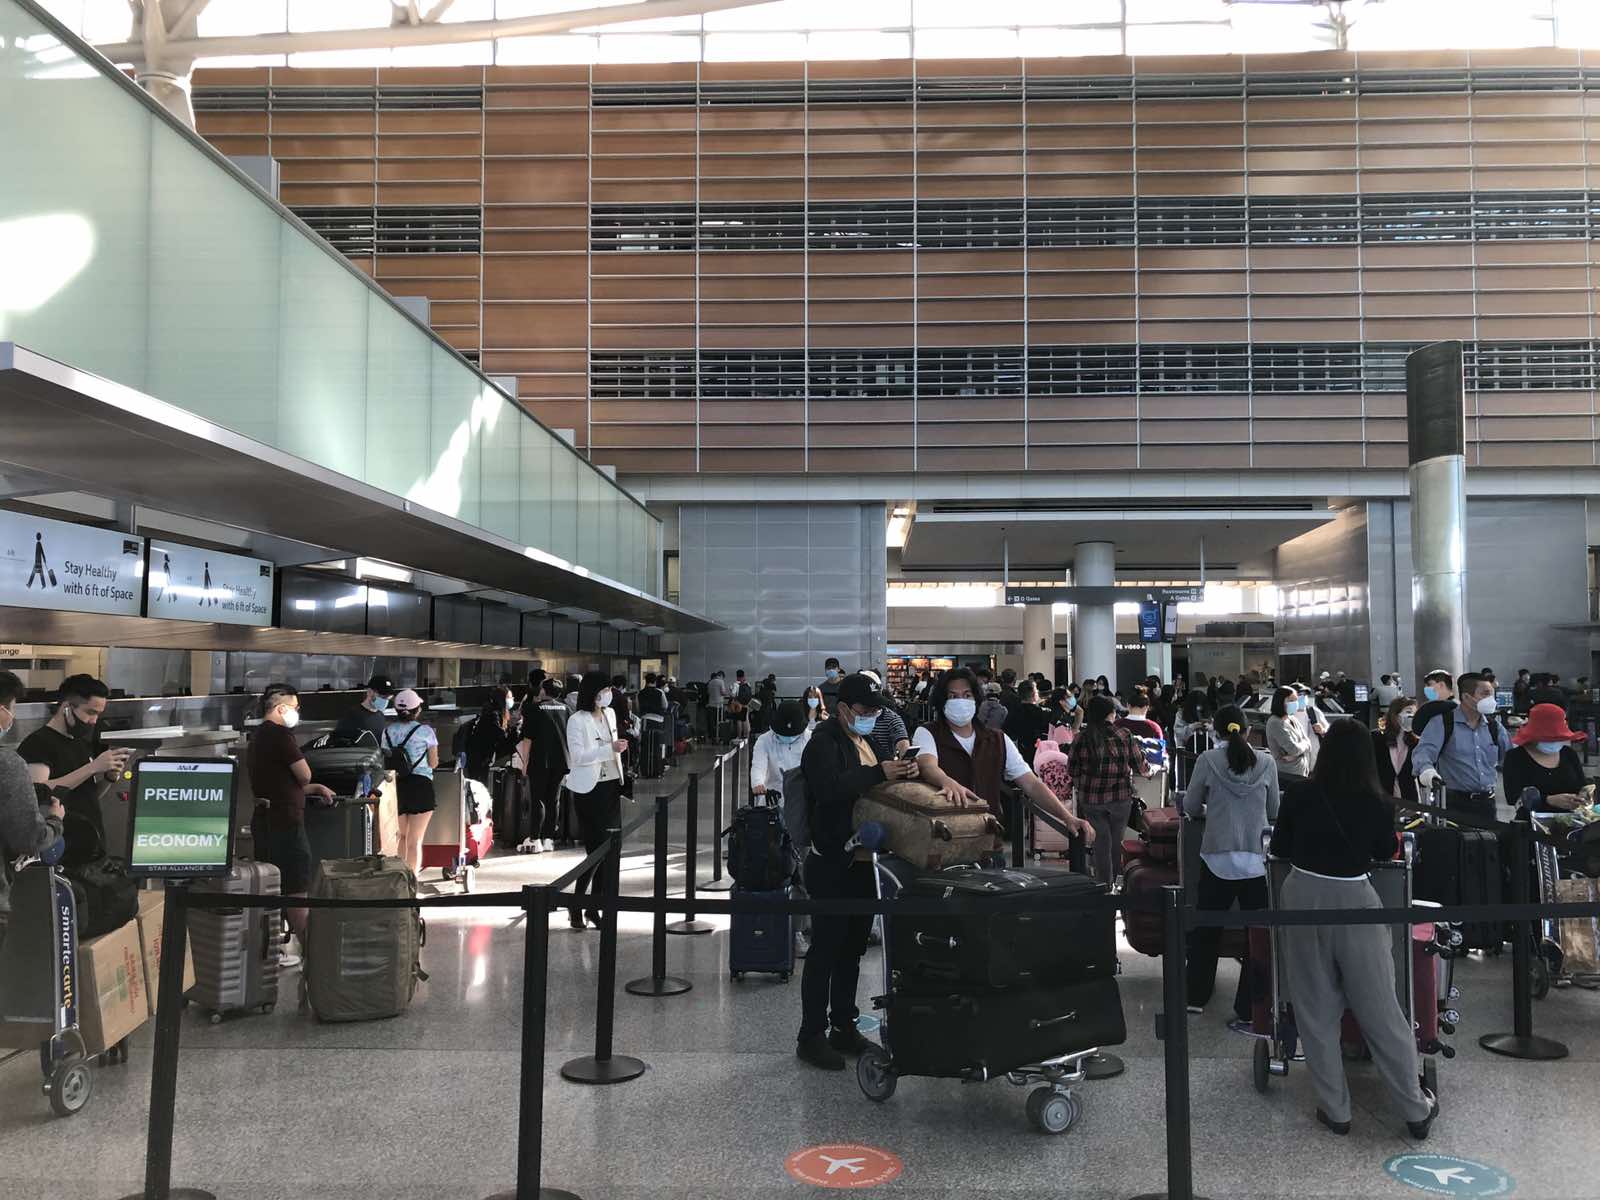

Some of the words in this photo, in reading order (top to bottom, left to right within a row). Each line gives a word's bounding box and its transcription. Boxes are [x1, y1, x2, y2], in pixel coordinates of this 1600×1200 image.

[64, 560, 84, 577] Stay
[86, 564, 117, 581] Healthy
[63, 581, 83, 595] with
[85, 584, 90, 596] 6
[92, 583, 99, 596] ft
[100, 586, 110, 597] of
[110, 586, 134, 601] Space
[144, 788, 223, 801] PREMIUM
[137, 834, 225, 847] ECONOMY
